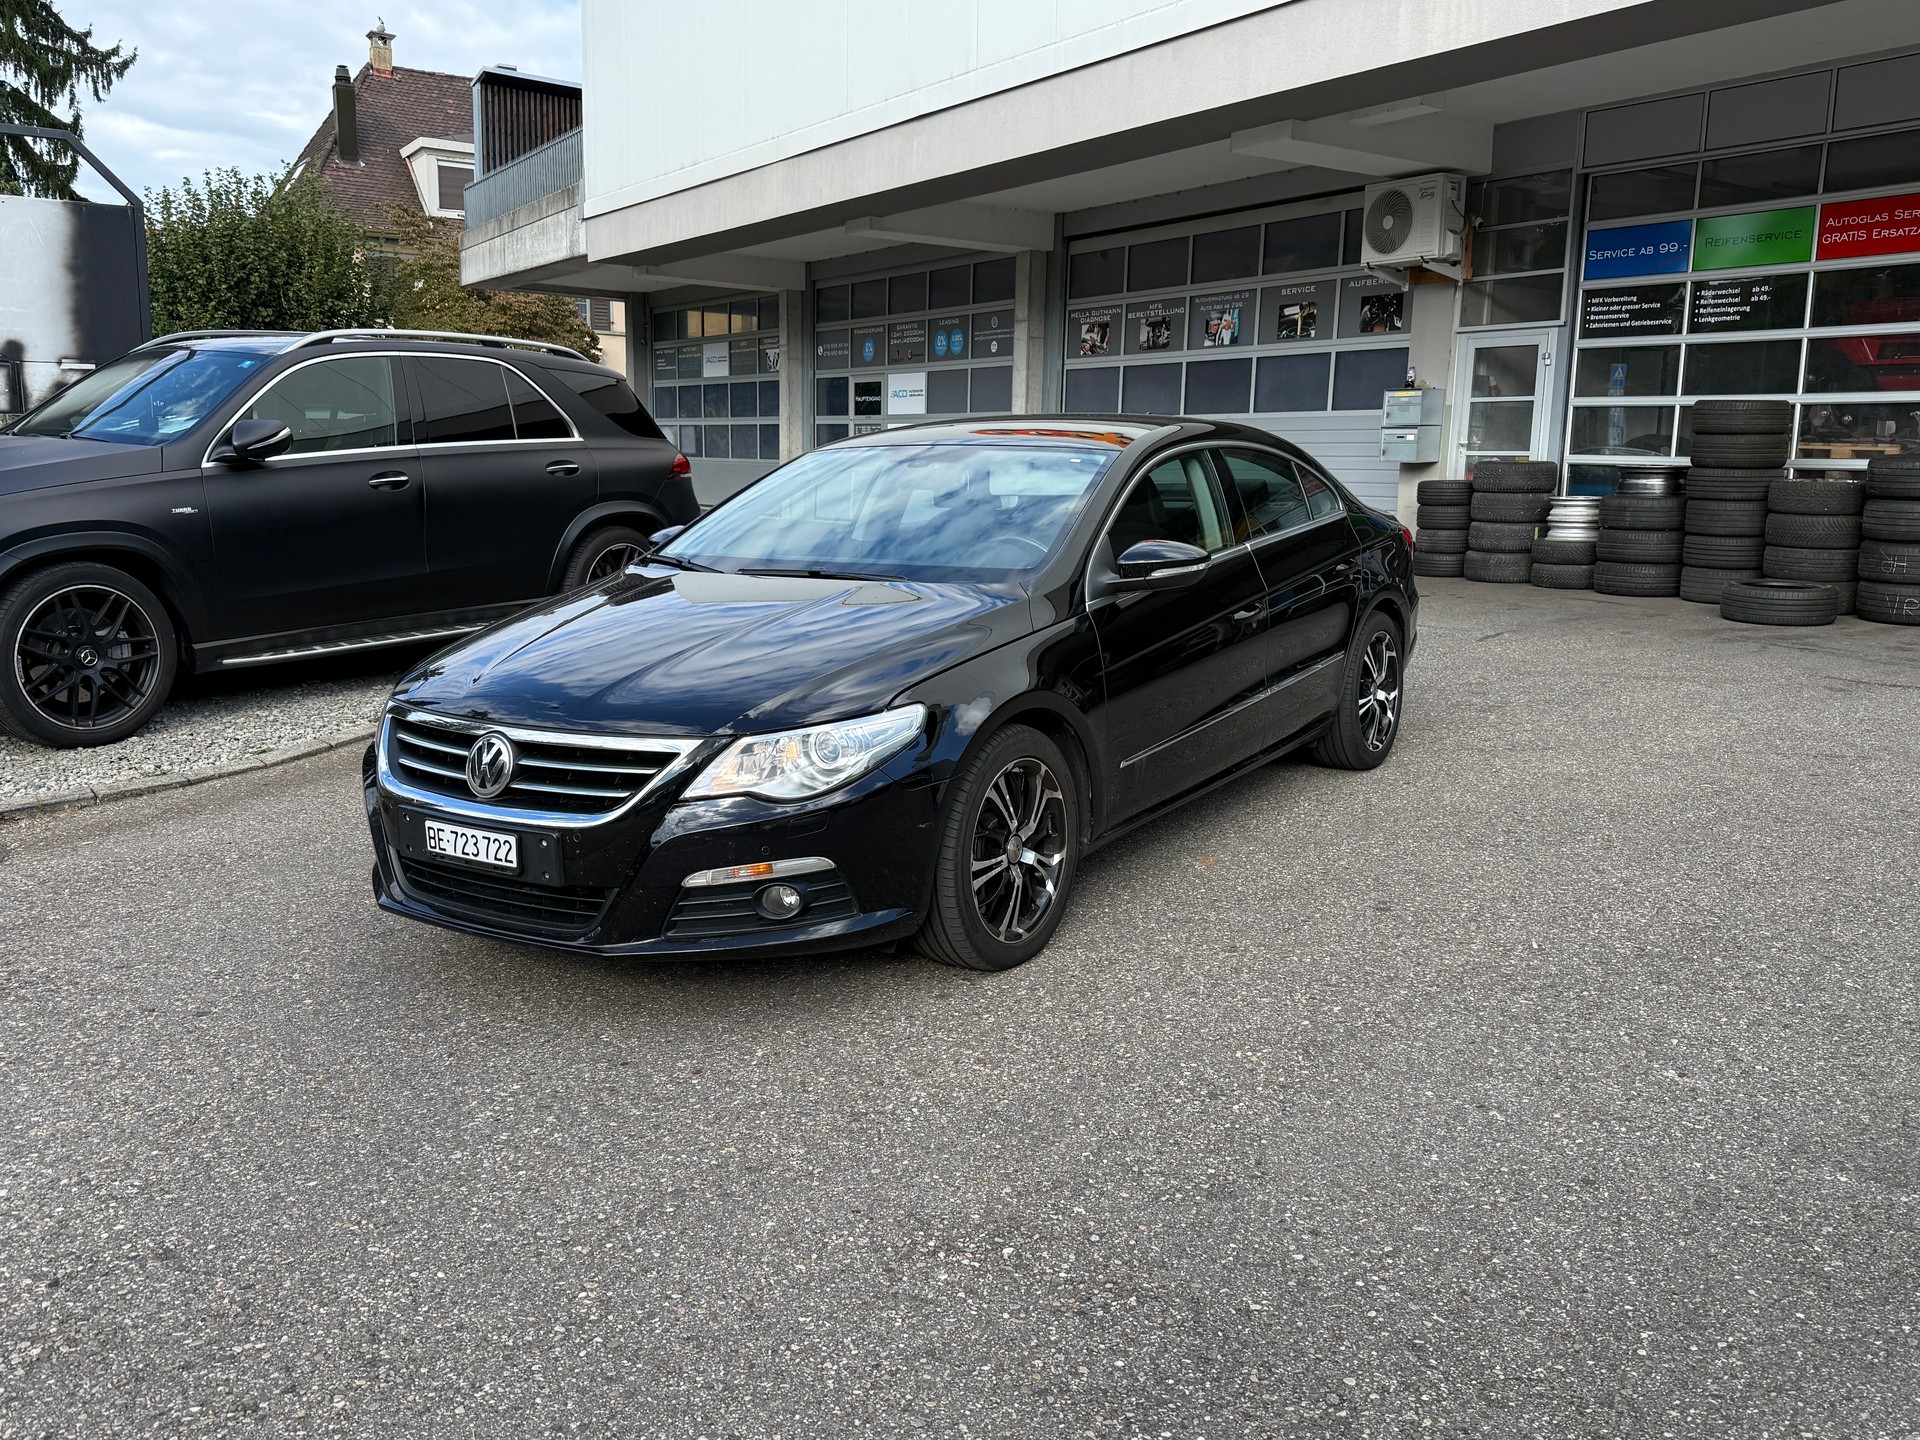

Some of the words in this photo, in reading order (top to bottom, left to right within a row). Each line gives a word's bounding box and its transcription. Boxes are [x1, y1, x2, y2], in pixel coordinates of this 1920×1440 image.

[1826, 213, 1888, 227] AUTOGLAS
[1894, 209, 1920, 220] SER
[1705, 229, 1803, 248] REIFENSERVICE
[1822, 230, 1867, 244] GRATIS
[1588, 247, 1636, 261] SERVICE
[1639, 246, 1654, 256] AB
[1659, 242, 1688, 254] 99.-
[1281, 285, 1316, 296] SERVICE
[1701, 288, 1740, 296] Räderwechsel
[1700, 297, 1740, 305] Reifenwechsel
[1091, 308, 1121, 317] GUTMANN
[1127, 307, 1185, 319] BEREITSTELLUNG
[1699, 305, 1751, 314] Reifeneinlagerung
[939, 318, 959, 326] LEASING
[1080, 315, 1111, 324] DIAGNOSE
[1631, 319, 1672, 327] Getriebeservice
[1698, 315, 1740, 323] Lenkgeometrie
[854, 326, 883, 335] FINANZIERUNG
[896, 323, 918, 331] GARANTIE
